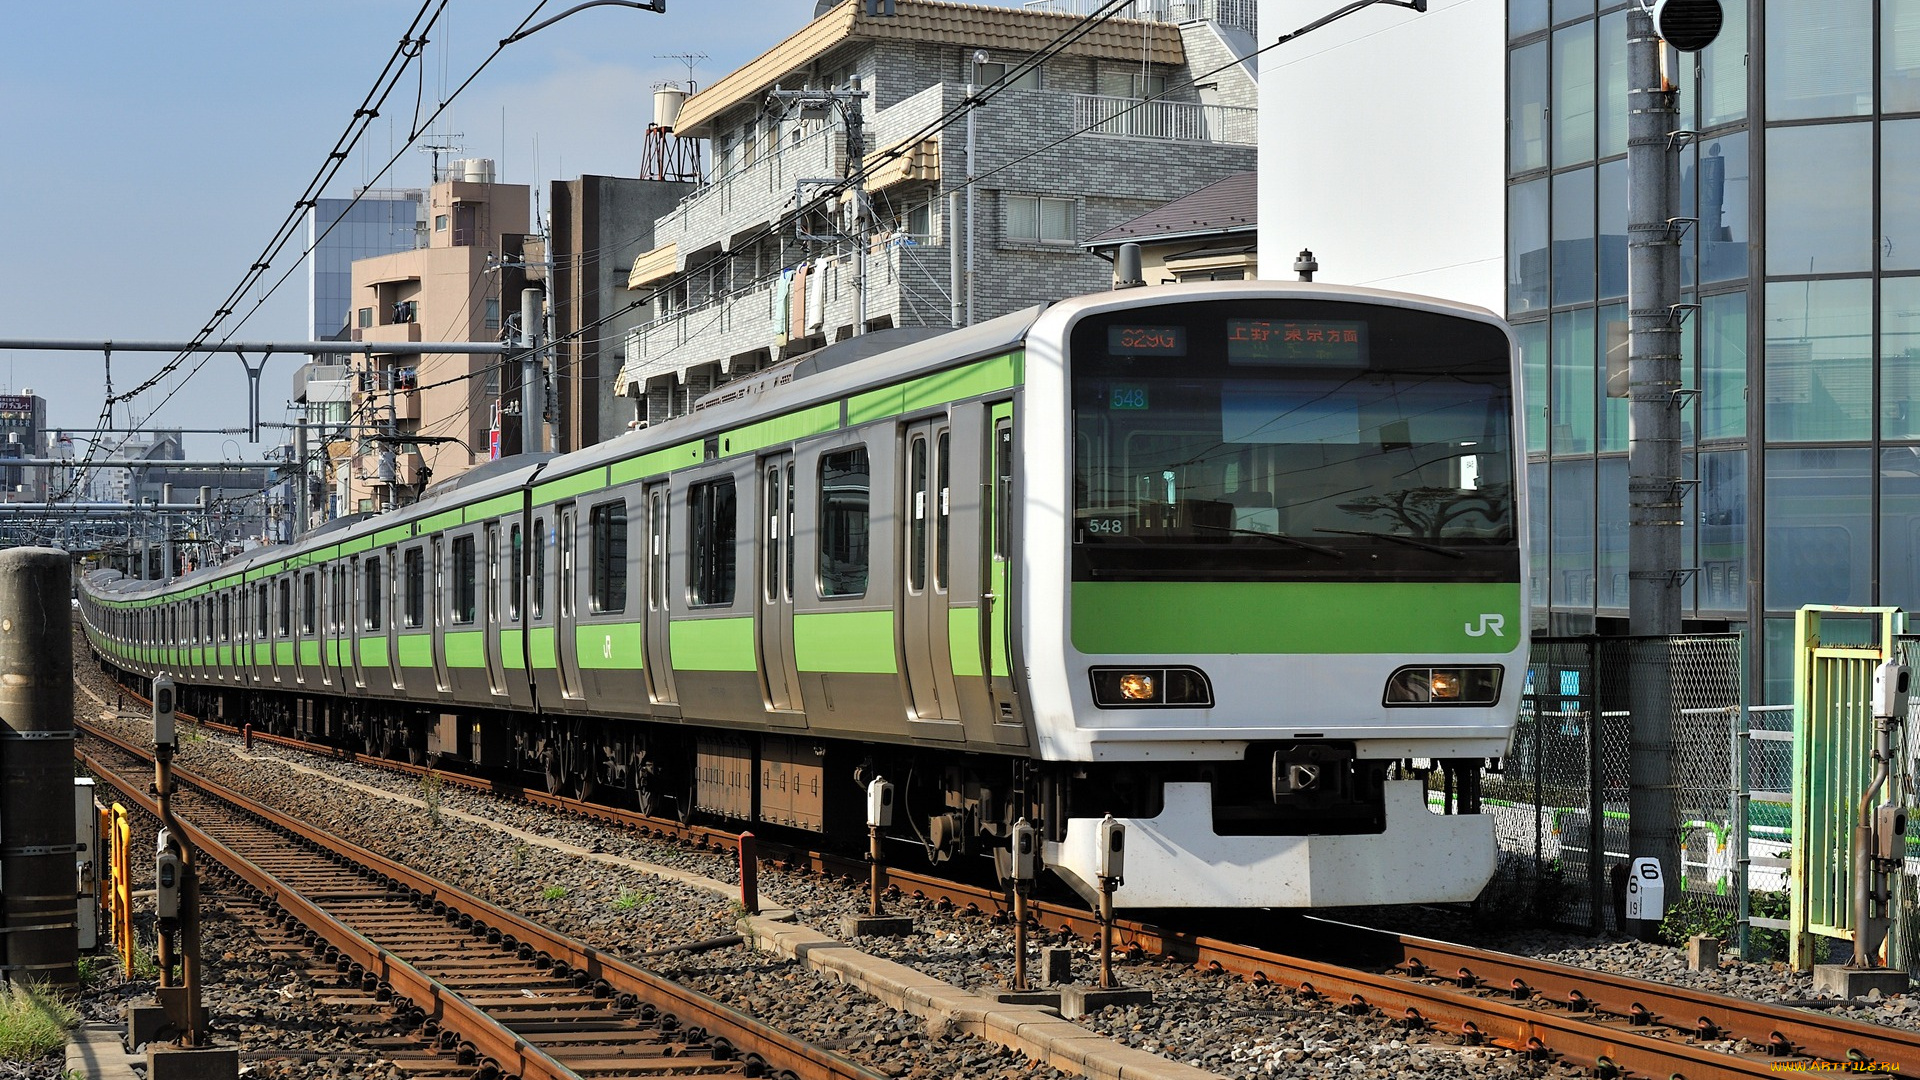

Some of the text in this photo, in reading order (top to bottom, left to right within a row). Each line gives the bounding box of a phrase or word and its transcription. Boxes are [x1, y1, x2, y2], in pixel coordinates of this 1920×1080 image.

[1113, 389, 1144, 407] 548
[1089, 519, 1122, 533] 548
[1464, 613, 1505, 637] JR
[602, 634, 612, 659] JR
[1640, 863, 1659, 880] 6
[1629, 875, 1639, 894] 6
[1629, 901, 1638, 916] 19
